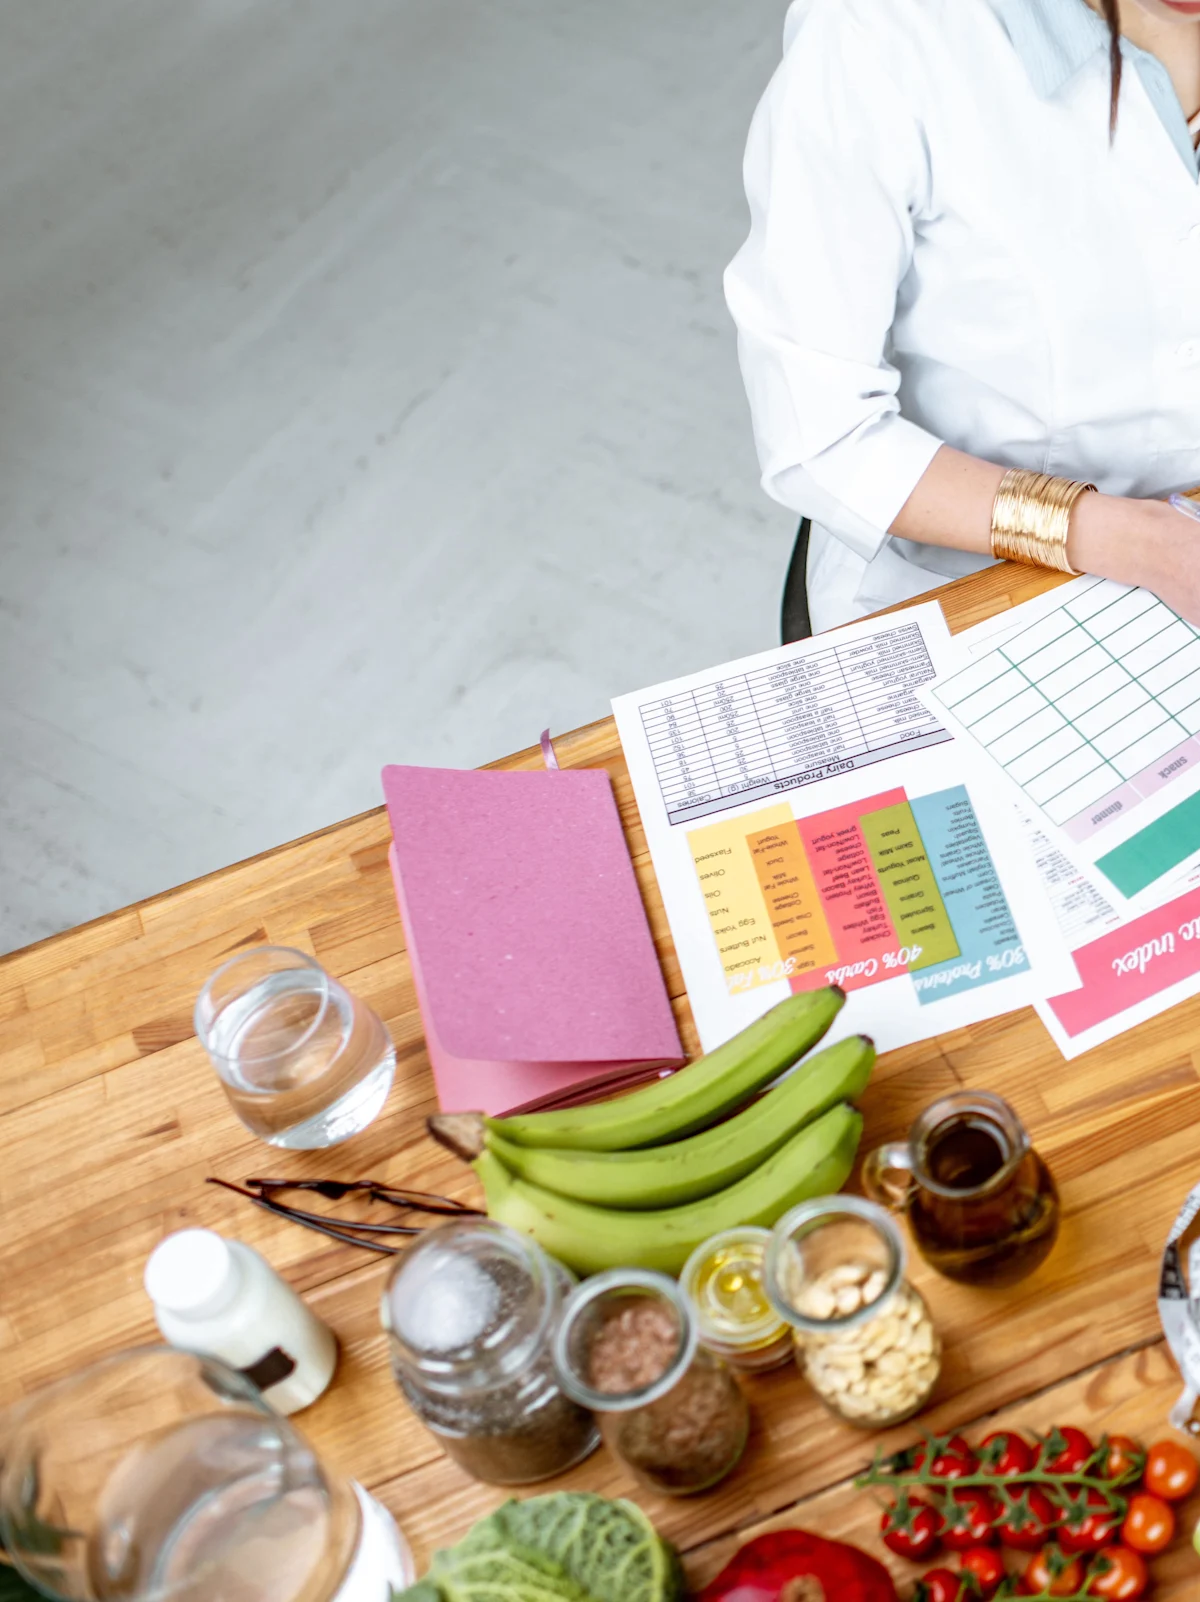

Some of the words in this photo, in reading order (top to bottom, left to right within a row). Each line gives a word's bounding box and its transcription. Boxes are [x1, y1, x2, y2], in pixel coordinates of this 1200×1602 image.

[872, 630, 896, 641] cheese
[849, 645, 873, 656] powder
[776, 662, 791, 670] slice
[850, 660, 874, 672] yoghurt
[768, 666, 804, 680] tablespoon
[789, 674, 806, 682] large
[871, 670, 895, 680] cheese
[770, 678, 788, 688] glass
[882, 674, 907, 686] yoghurt
[774, 692, 792, 703] glass
[794, 688, 811, 697] large
[820, 706, 832, 714] half
[876, 701, 900, 711] cheese
[895, 703, 919, 714] cheese
[783, 712, 812, 725] teaspoon
[784, 719, 815, 732] teaspoon
[787, 725, 823, 740] tablespoon
[827, 728, 840, 736] one
[898, 729, 921, 740] Food
[670, 735, 682, 743] 101
[789, 732, 825, 747] tablespoon
[791, 740, 828, 755] tablespoon
[832, 743, 845, 751] half
[795, 749, 825, 763] teaspoon
[804, 754, 840, 769] Measure
[825, 759, 854, 774] Dairy
[1157, 755, 1188, 778] snack
[740, 775, 769, 789] Weight
[773, 769, 823, 790] Products
[726, 783, 739, 793] (g)
[676, 793, 711, 808] Calories
[945, 799, 968, 810] Sugars
[1090, 800, 1123, 825] dinner
[835, 825, 856, 836] greek
[880, 828, 900, 837] Peas
[757, 835, 779, 845] Yogurt
[811, 832, 834, 844] yogurt
[752, 839, 787, 854] Whole-Fat
[835, 842, 861, 853] cheese
[878, 847, 893, 855] Milk
[895, 841, 913, 850] Skim
[694, 847, 731, 864] Flaxseed
[765, 856, 783, 865] Duck
[837, 849, 864, 862] cottage
[850, 865, 869, 875] Lean
[876, 861, 904, 873] Yogurts
[699, 868, 725, 880] Olives
[832, 872, 849, 881] Beef
[846, 874, 872, 884] Turkey
[776, 875, 798, 886] Whole
[763, 882, 775, 891] Fat
[823, 881, 845, 892] Bacon
[704, 889, 721, 898] Oils
[825, 889, 851, 900] Protein
[899, 890, 924, 901] Grains
[709, 907, 729, 916] Nuts
[869, 913, 885, 921] Egg
[737, 917, 755, 927] Egg
[862, 922, 887, 933] Turkey
[713, 925, 736, 935] Yolks
[910, 923, 935, 934] Beans
[751, 935, 766, 944] Nut
[718, 939, 749, 953] Butters
[882, 945, 923, 969] 40%
[986, 946, 1026, 970] 30%
[1111, 931, 1175, 976] index
[824, 958, 878, 985] Carbs
